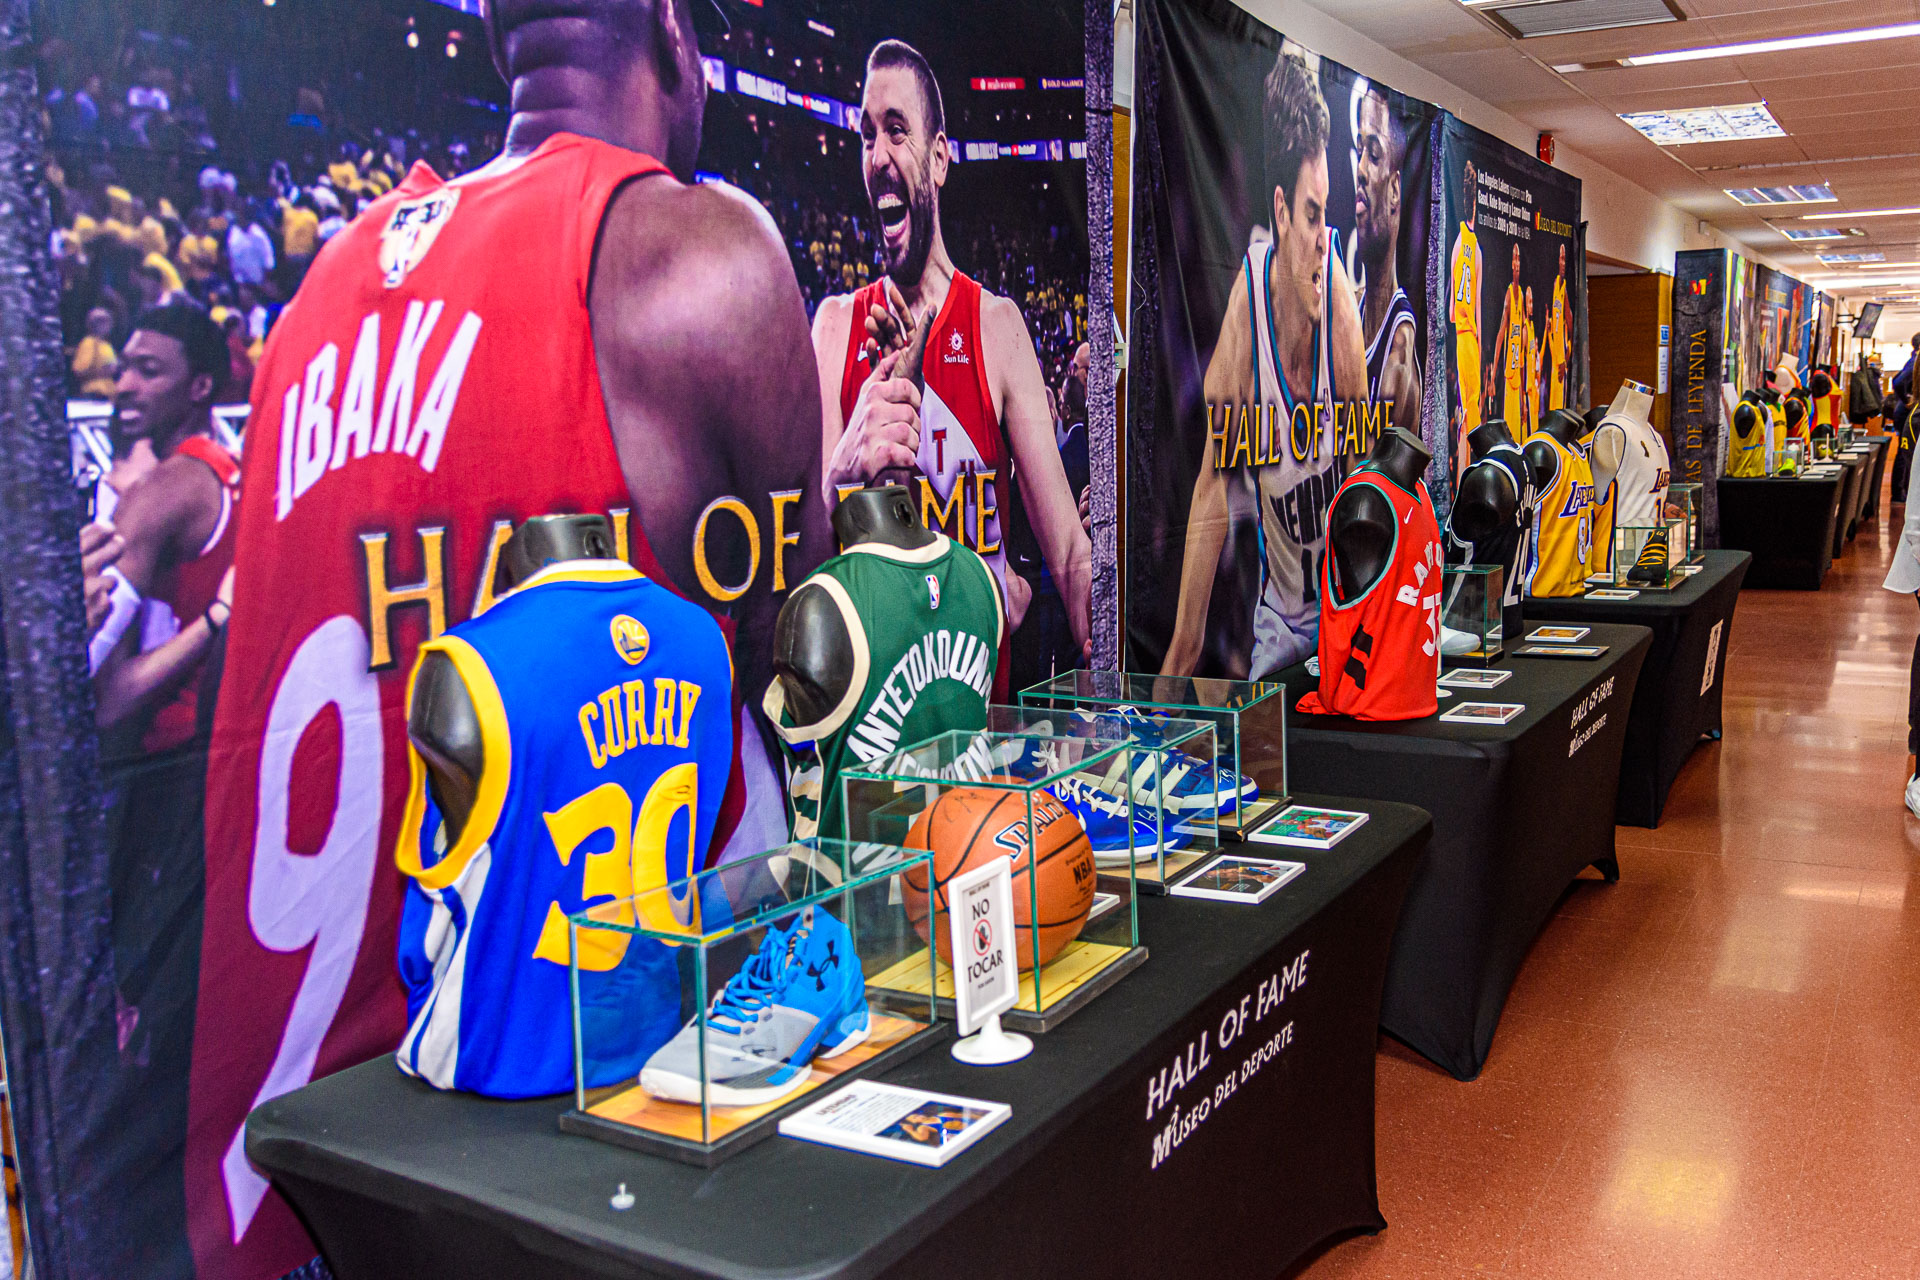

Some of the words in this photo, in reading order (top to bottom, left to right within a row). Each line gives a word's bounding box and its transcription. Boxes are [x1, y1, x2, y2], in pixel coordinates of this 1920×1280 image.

[944, 354, 957, 364] Sun
[957, 354, 970, 365] Life
[1687, 329, 1707, 413] LEYENDA
[275, 300, 483, 522] IBAKA
[1207, 403, 1282, 468] HALL
[1290, 402, 1325, 461] OF
[1686, 424, 1704, 449] DE
[692, 488, 803, 602] OF
[578, 678, 701, 769] CURRY
[1571, 696, 1589, 730] HALL
[1588, 686, 1600, 711] OF
[1598, 675, 1615, 704] FAME
[532, 762, 702, 972] 30
[1072, 856, 1093, 885] NBA
[222, 614, 384, 1245] 9
[972, 898, 990, 921] NO
[967, 949, 1004, 984] TOCAR
[1146, 1030, 1211, 1121] HALL
[1218, 994, 1251, 1049] OF
[1255, 949, 1310, 1022] FAME
[1214, 1070, 1238, 1109] DEL
[1240, 1020, 1294, 1084] DEPORTE
